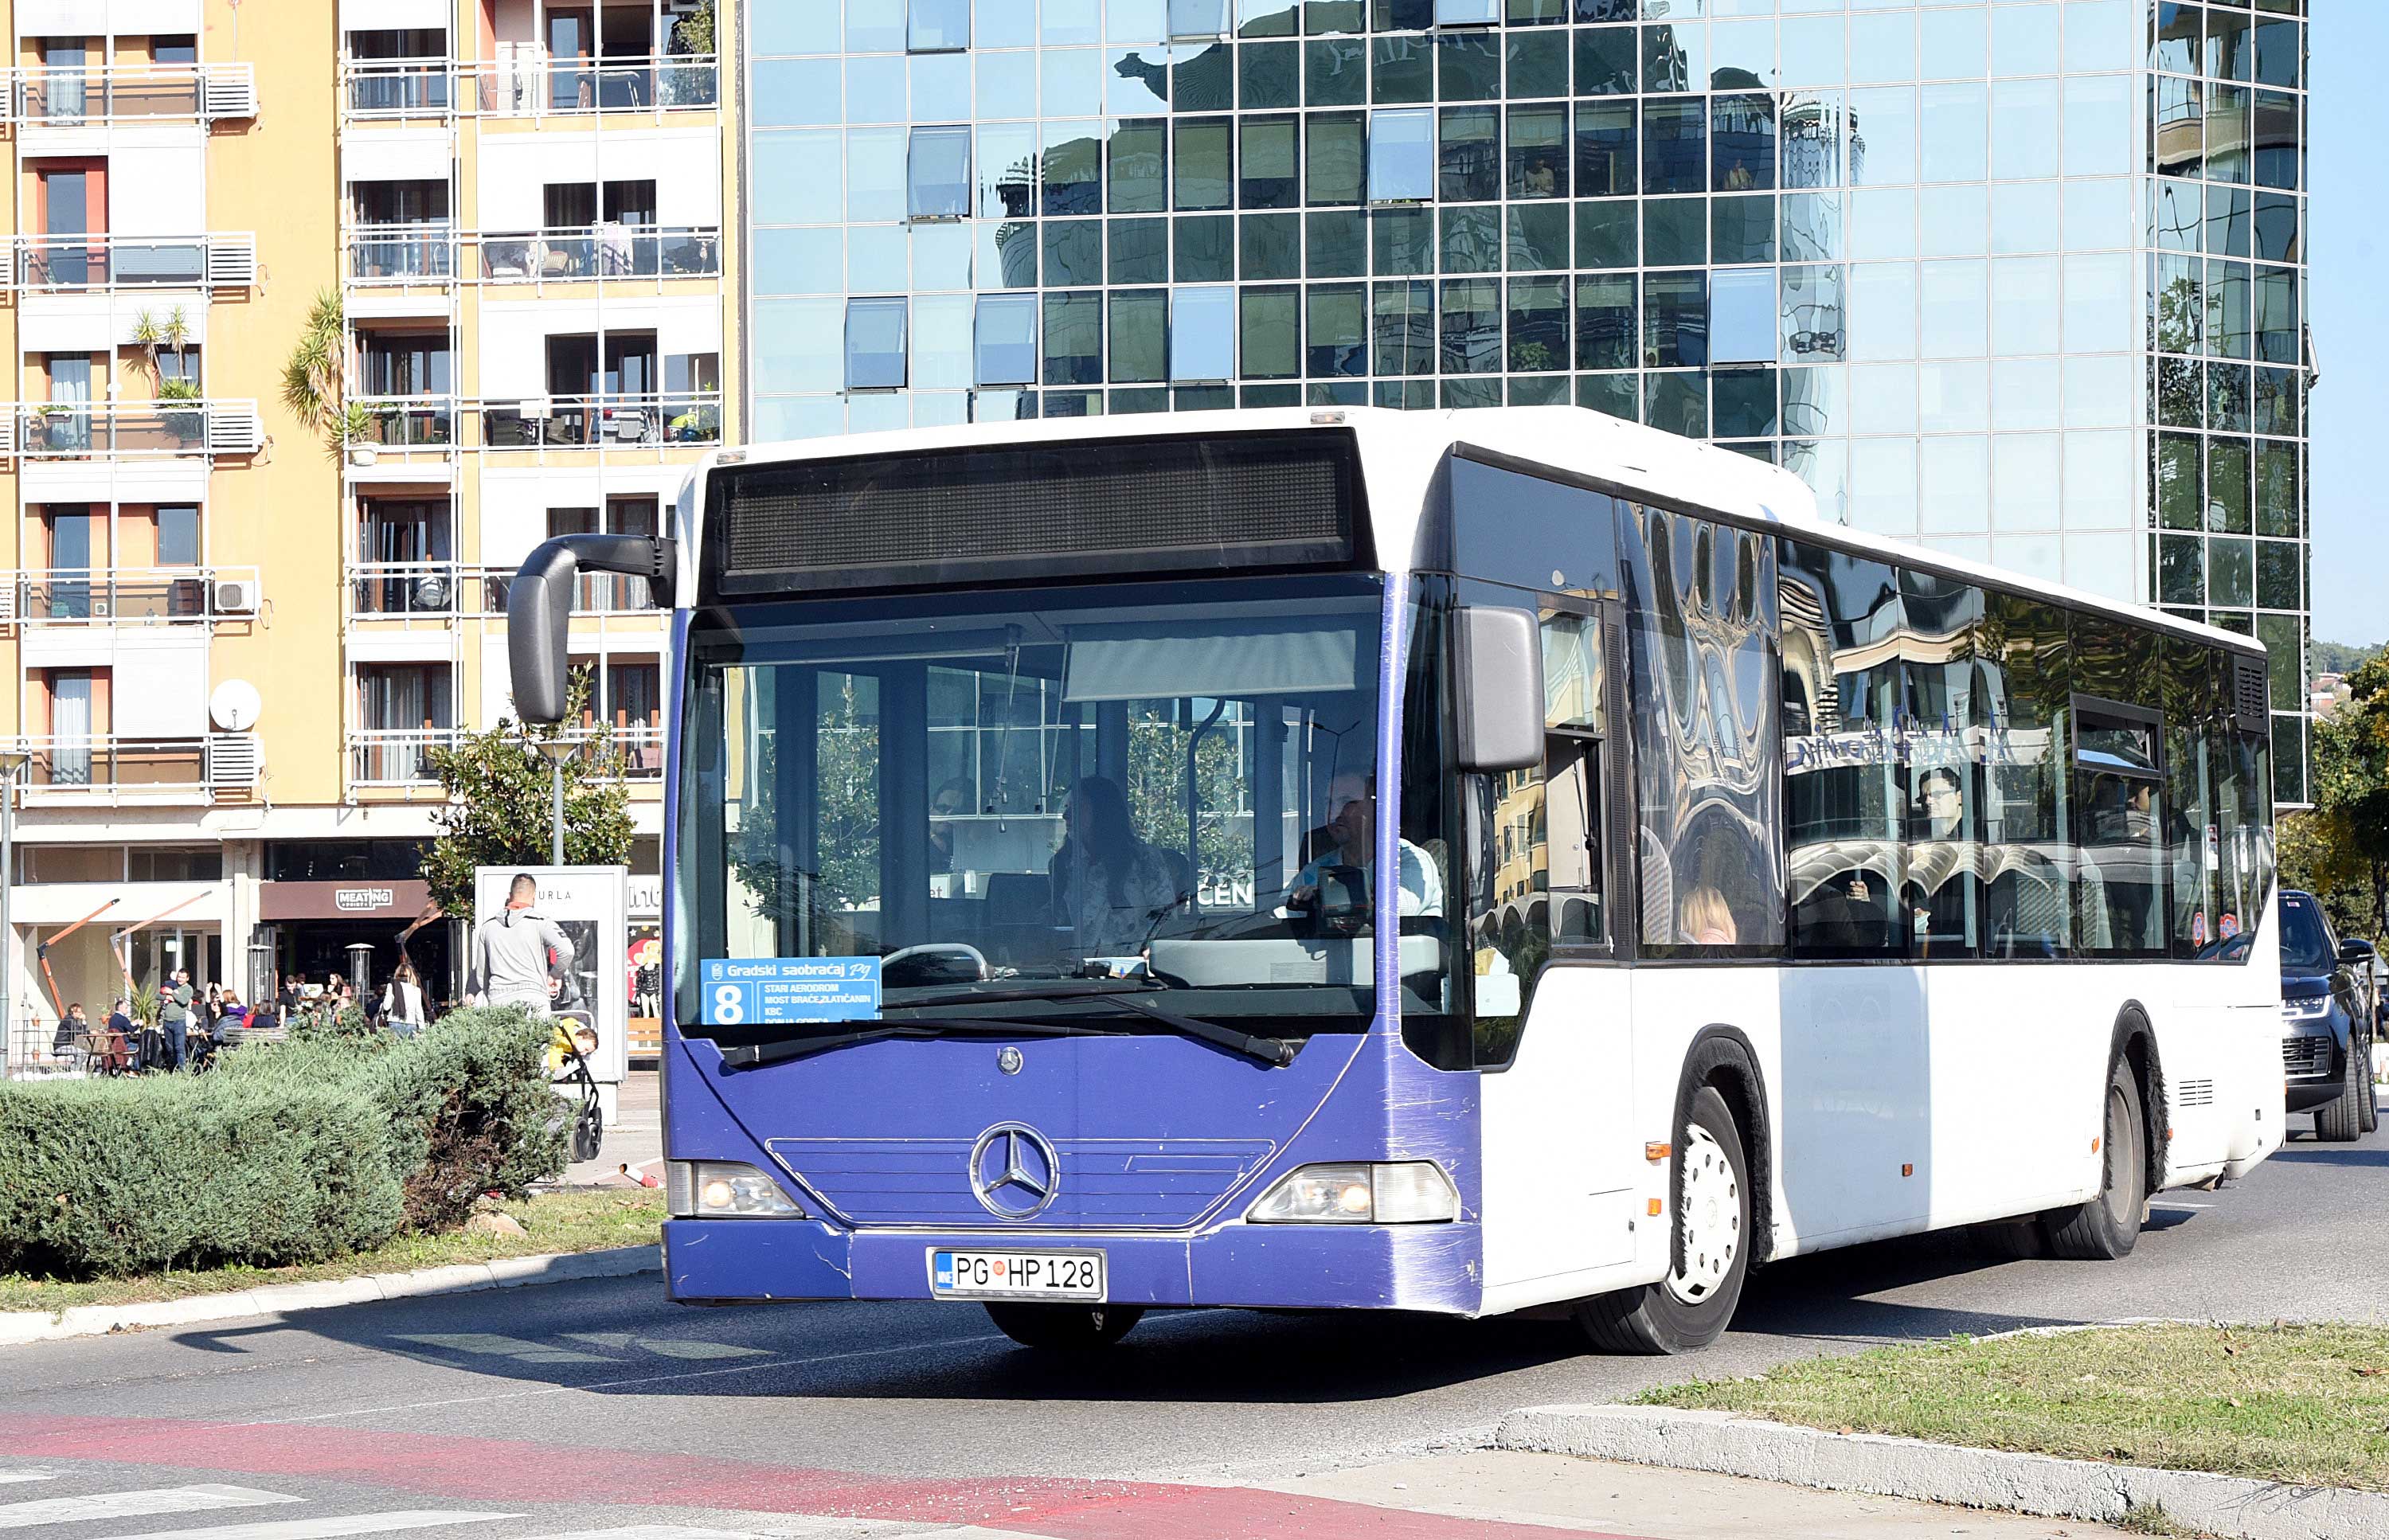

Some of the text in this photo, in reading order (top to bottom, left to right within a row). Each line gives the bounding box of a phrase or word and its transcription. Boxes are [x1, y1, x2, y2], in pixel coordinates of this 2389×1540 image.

[538, 890, 571, 900] URLA
[727, 964, 776, 977] Gradski
[782, 963, 846, 978] saobraćaj
[764, 983, 839, 993] STARI AERODROM
[714, 985, 743, 1025] 8
[764, 1007, 783, 1016] KBC
[957, 1257, 988, 1285] PG
